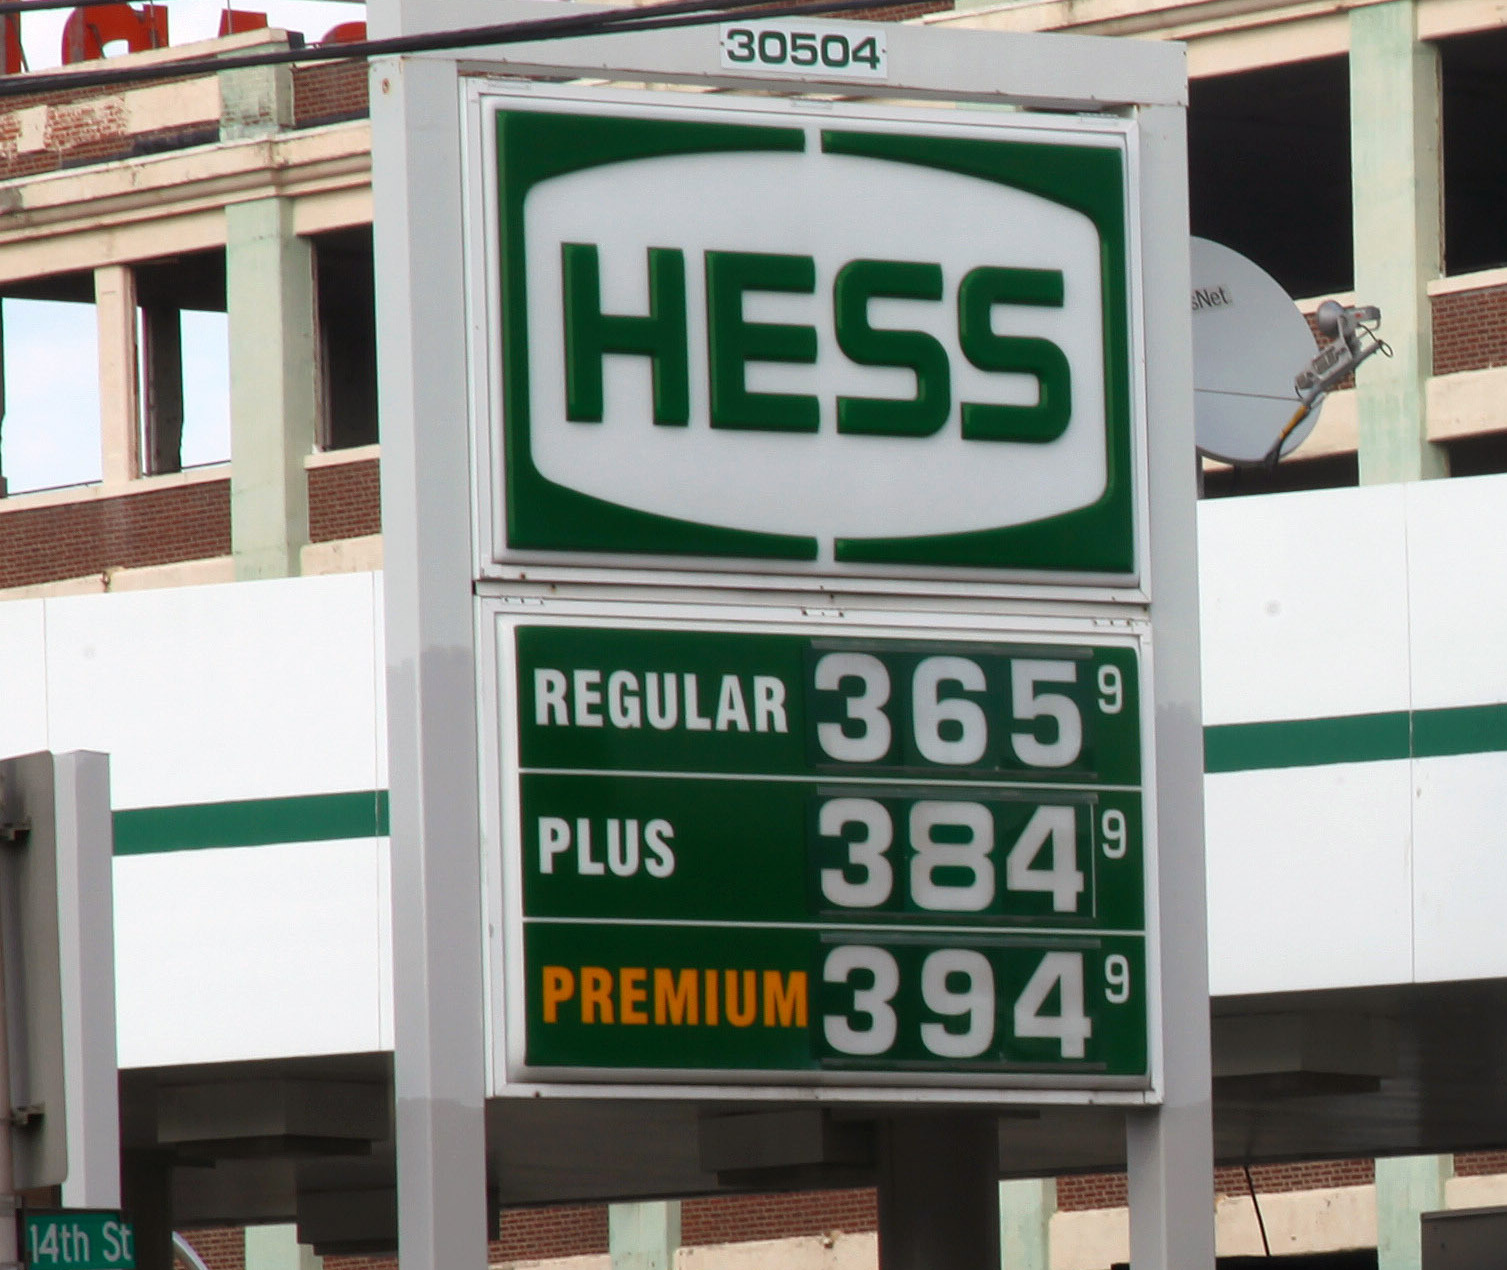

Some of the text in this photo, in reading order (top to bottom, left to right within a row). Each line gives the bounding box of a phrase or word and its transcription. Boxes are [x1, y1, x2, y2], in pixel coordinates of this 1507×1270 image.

[727, 28, 880, 70] 30504
[561, 242, 1072, 444] HESS
[534, 652, 1124, 768] REGULAR 365 9
[537, 797, 1127, 914] PLUS 384 9
[542, 944, 1130, 1059] PREMIUM 394 9
[30, 1220, 132, 1264] 14th St
